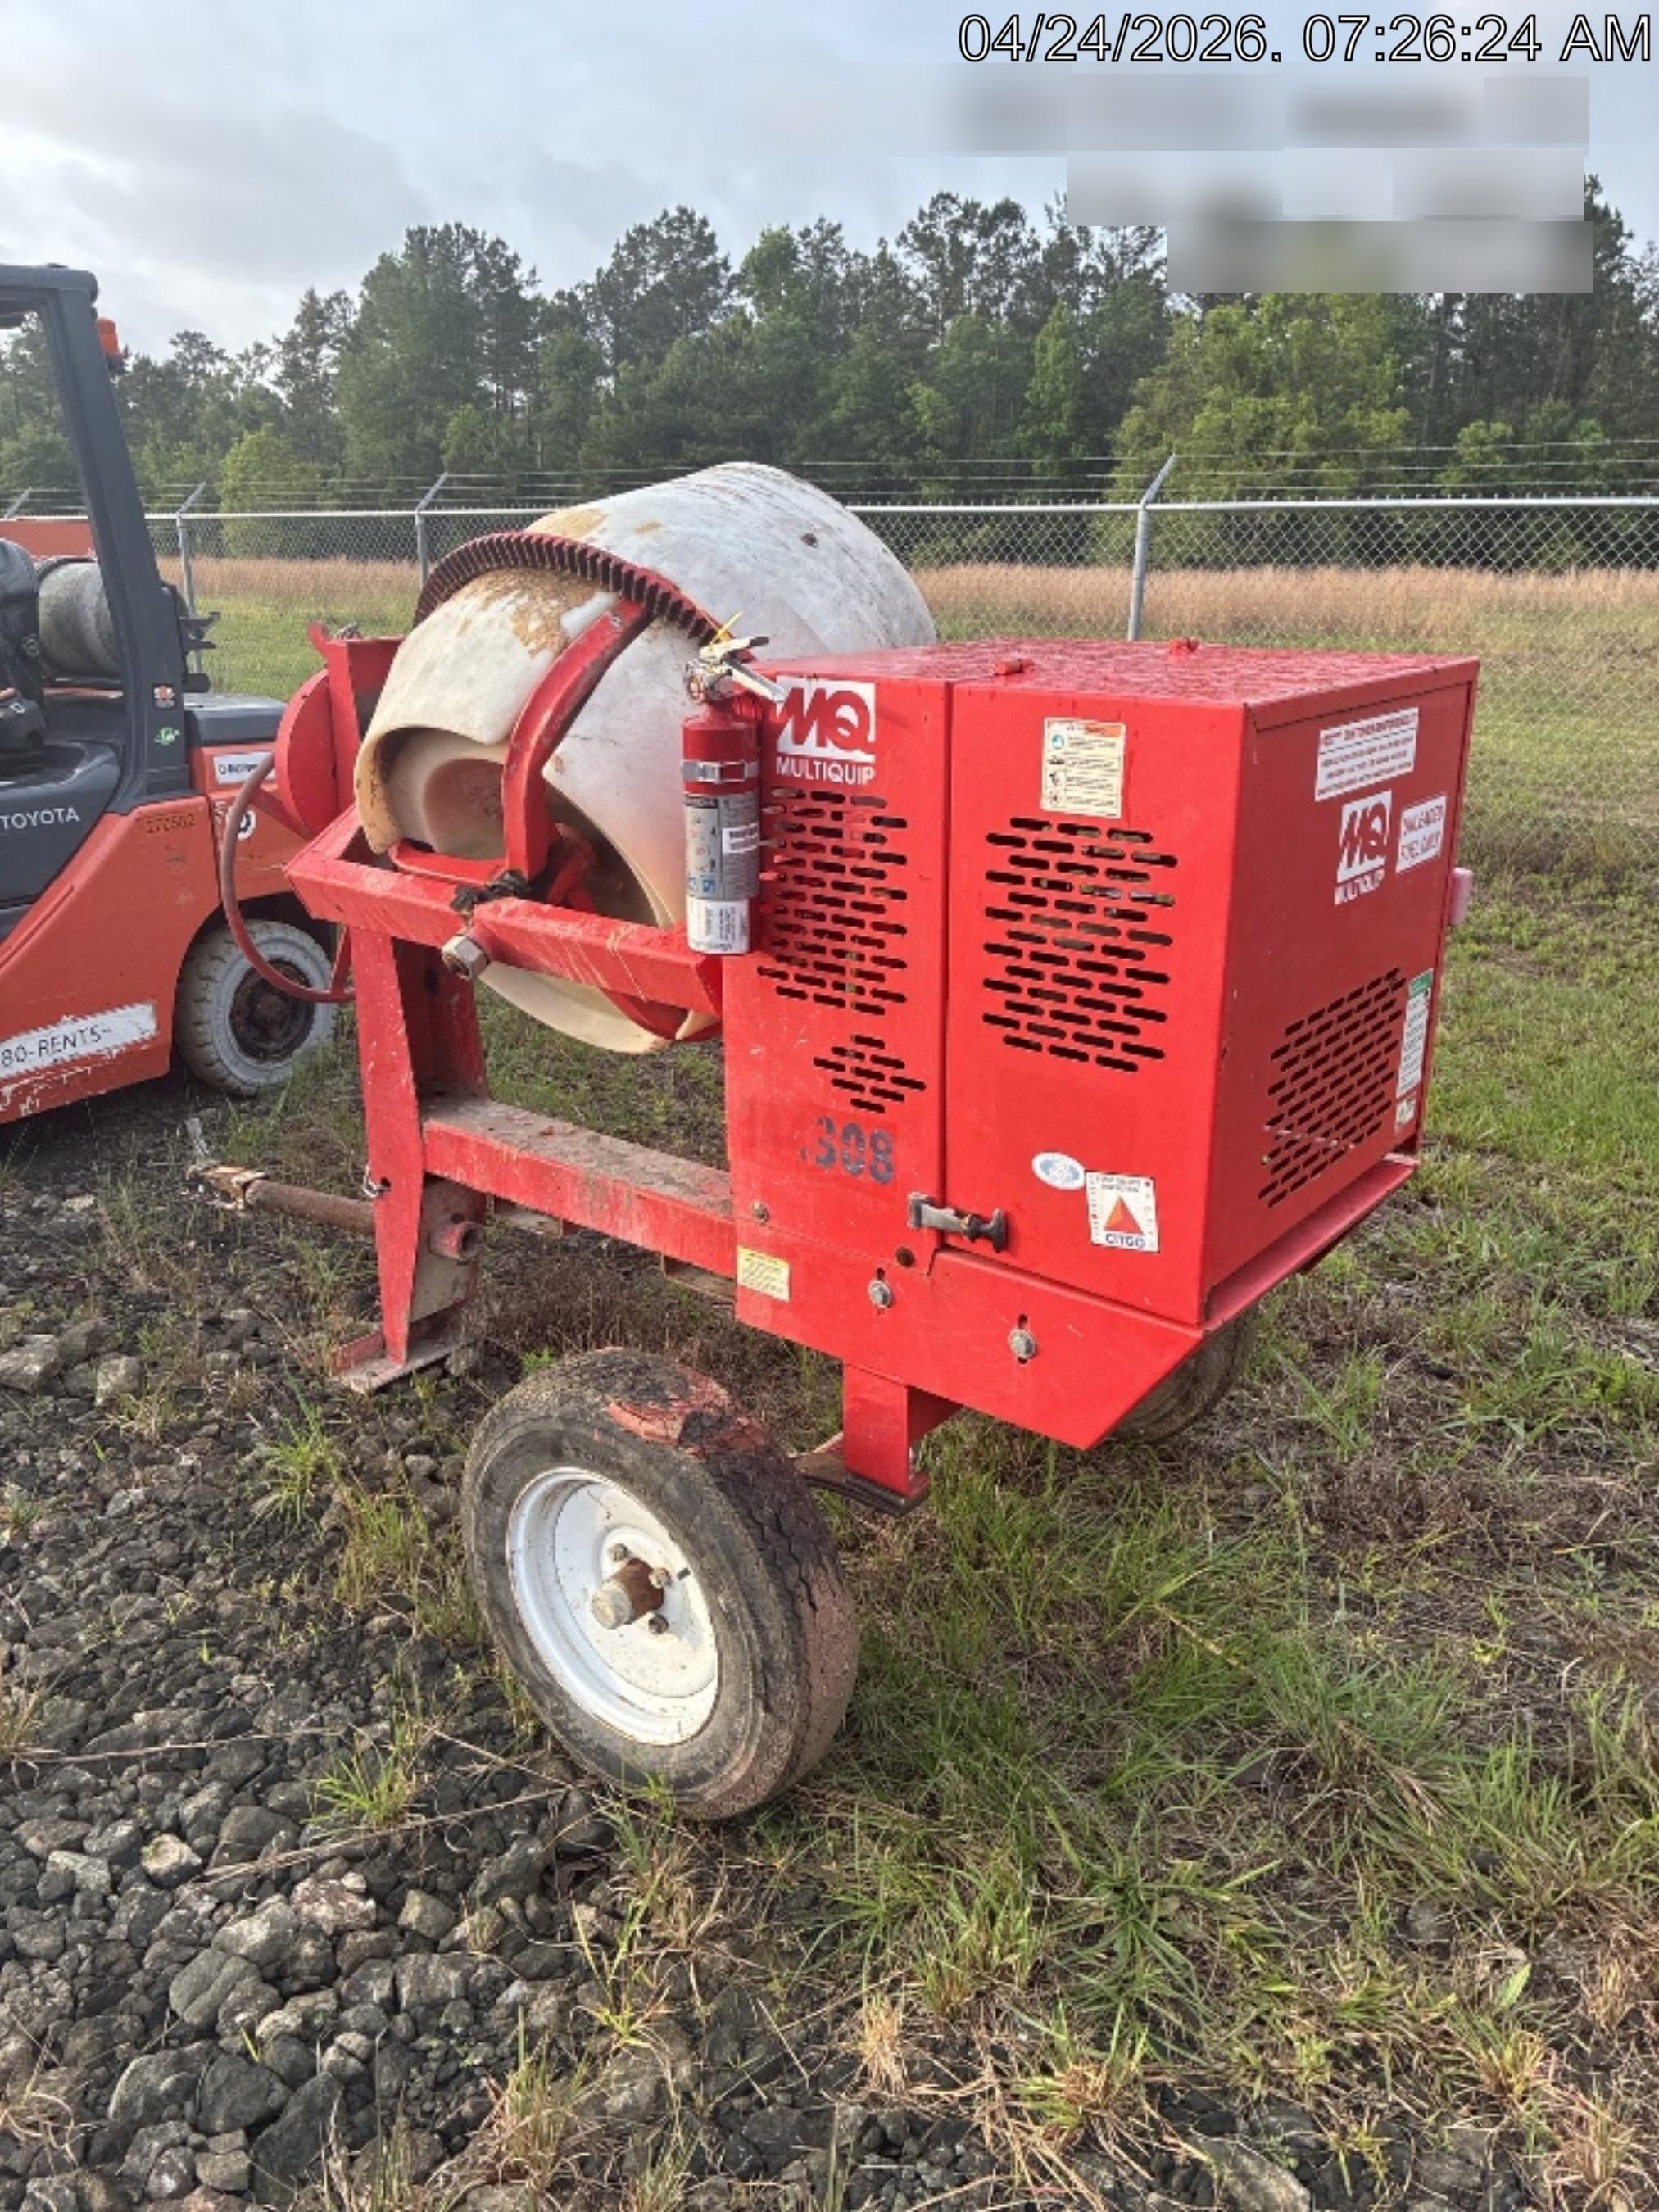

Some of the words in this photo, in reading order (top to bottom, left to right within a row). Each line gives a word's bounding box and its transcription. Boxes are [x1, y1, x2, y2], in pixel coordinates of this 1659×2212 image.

[773, 683, 875, 755] MQ
[775, 755, 876, 786] MULTIQUIP
[0, 806, 81, 829] TOYOTA
[1339, 799, 1389, 872] MQ
[816, 1115, 894, 1184] 308
